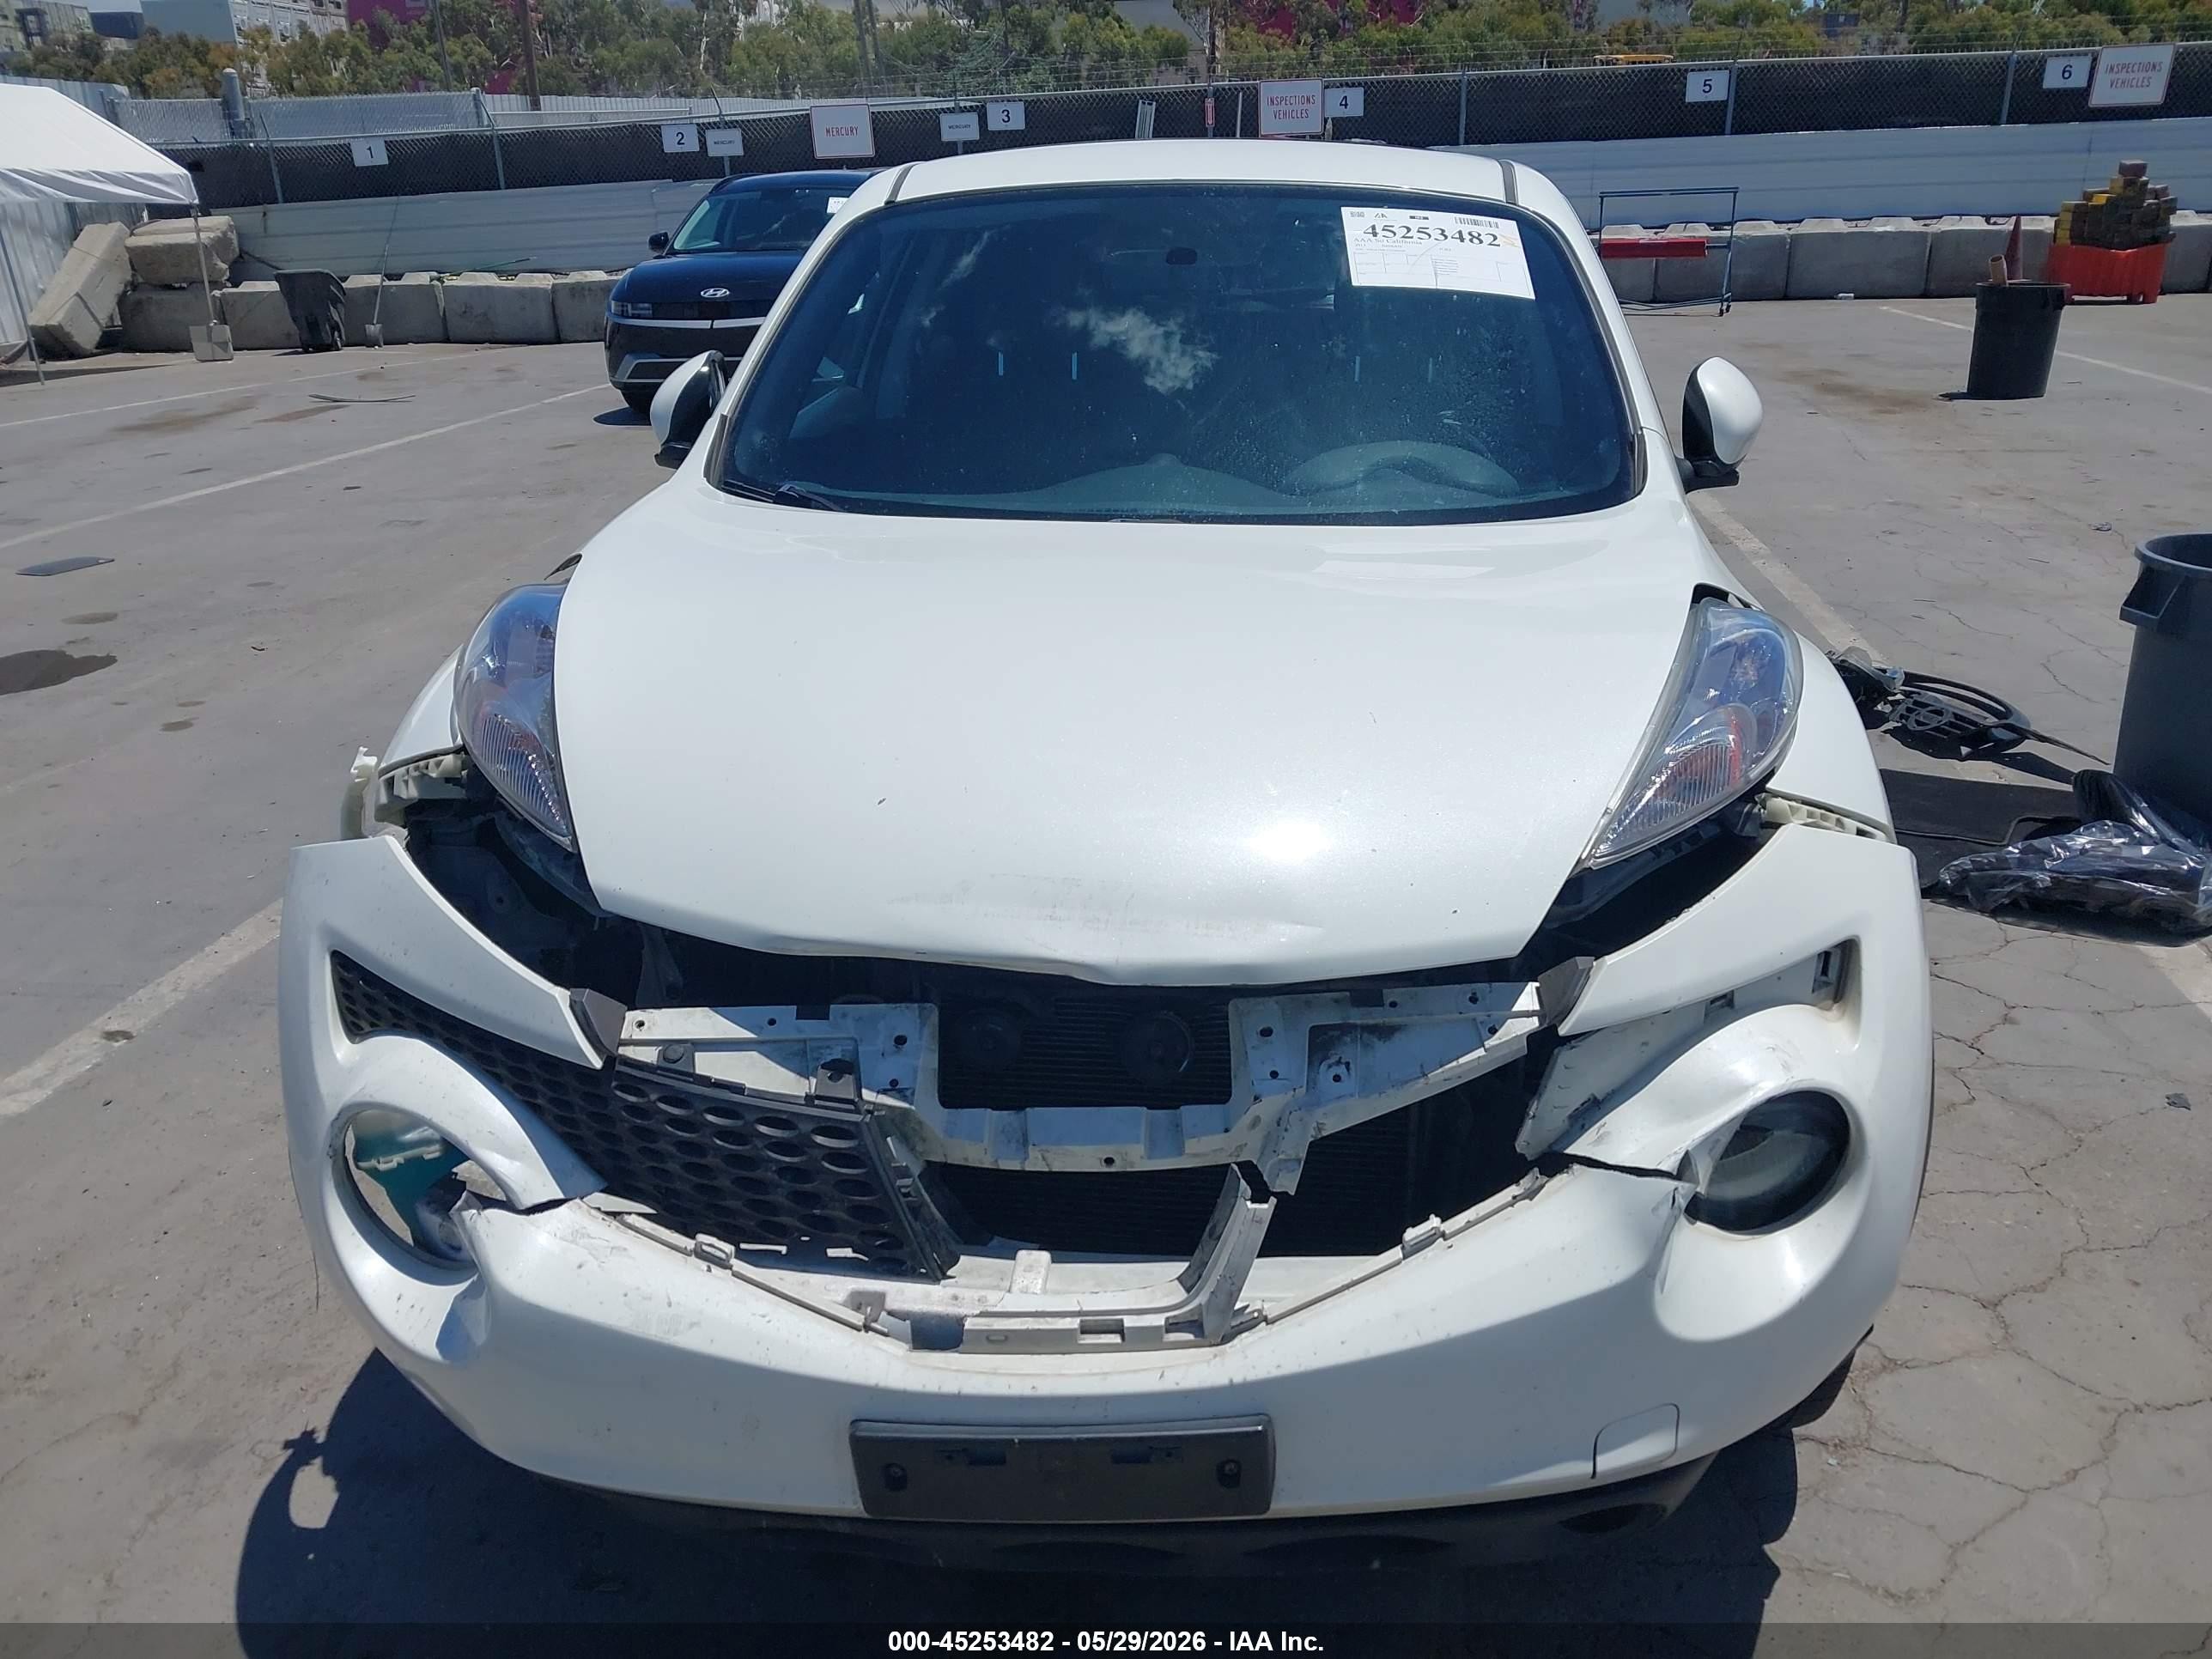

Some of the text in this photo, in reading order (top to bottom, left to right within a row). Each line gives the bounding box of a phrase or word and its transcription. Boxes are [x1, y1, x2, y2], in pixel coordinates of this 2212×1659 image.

[2062, 64, 2072, 79] 6
[2105, 61, 2163, 75] INSPECTIONS
[1703, 79, 1712, 93] 5
[2109, 76, 2152, 89] VEHICLES
[1267, 95, 1316, 106] INSPECTIONS
[1339, 95, 1349, 109] 4
[1001, 109, 1011, 123] 3
[1273, 109, 1310, 119] VEHICLES
[825, 126, 859, 137] MERCURY
[676, 132, 685, 146] 2
[366, 146, 374, 159] 1
[1363, 223, 1501, 247] 45253482
